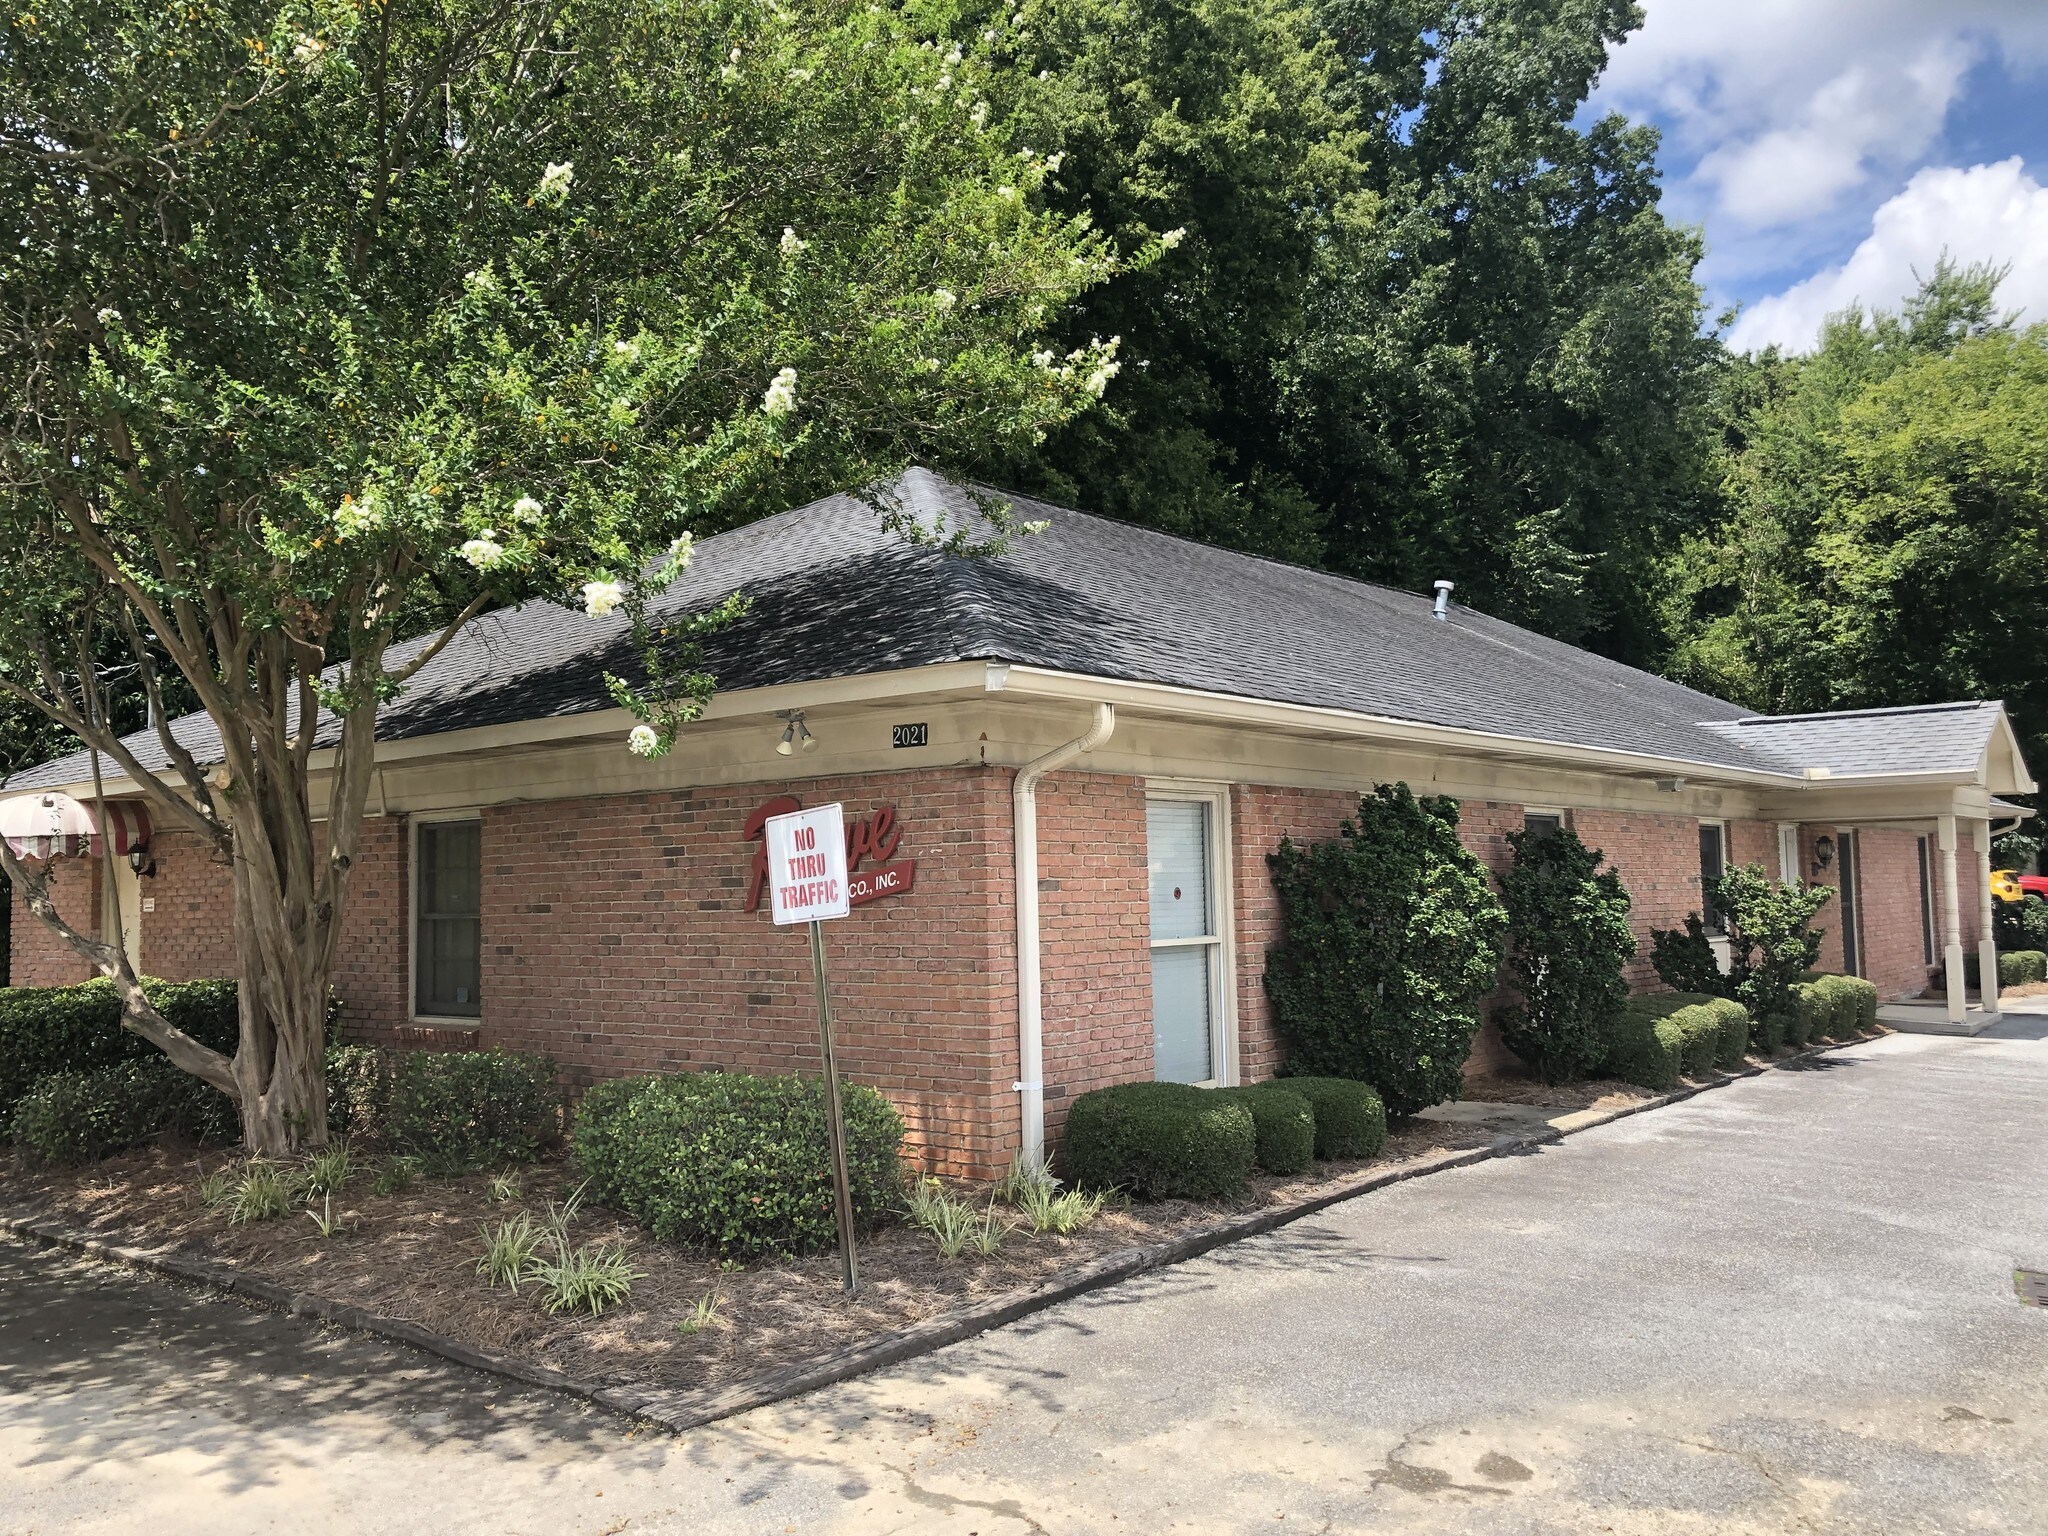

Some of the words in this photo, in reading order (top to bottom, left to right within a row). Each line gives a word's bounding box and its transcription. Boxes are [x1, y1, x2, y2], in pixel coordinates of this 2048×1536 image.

[893, 725, 926, 746] 2021
[794, 826, 815, 852] NO
[788, 852, 826, 881] THRU
[779, 878, 839, 909] TRAFFIC
[848, 880, 873, 898] CO.,
[875, 871, 900, 891] INC.
